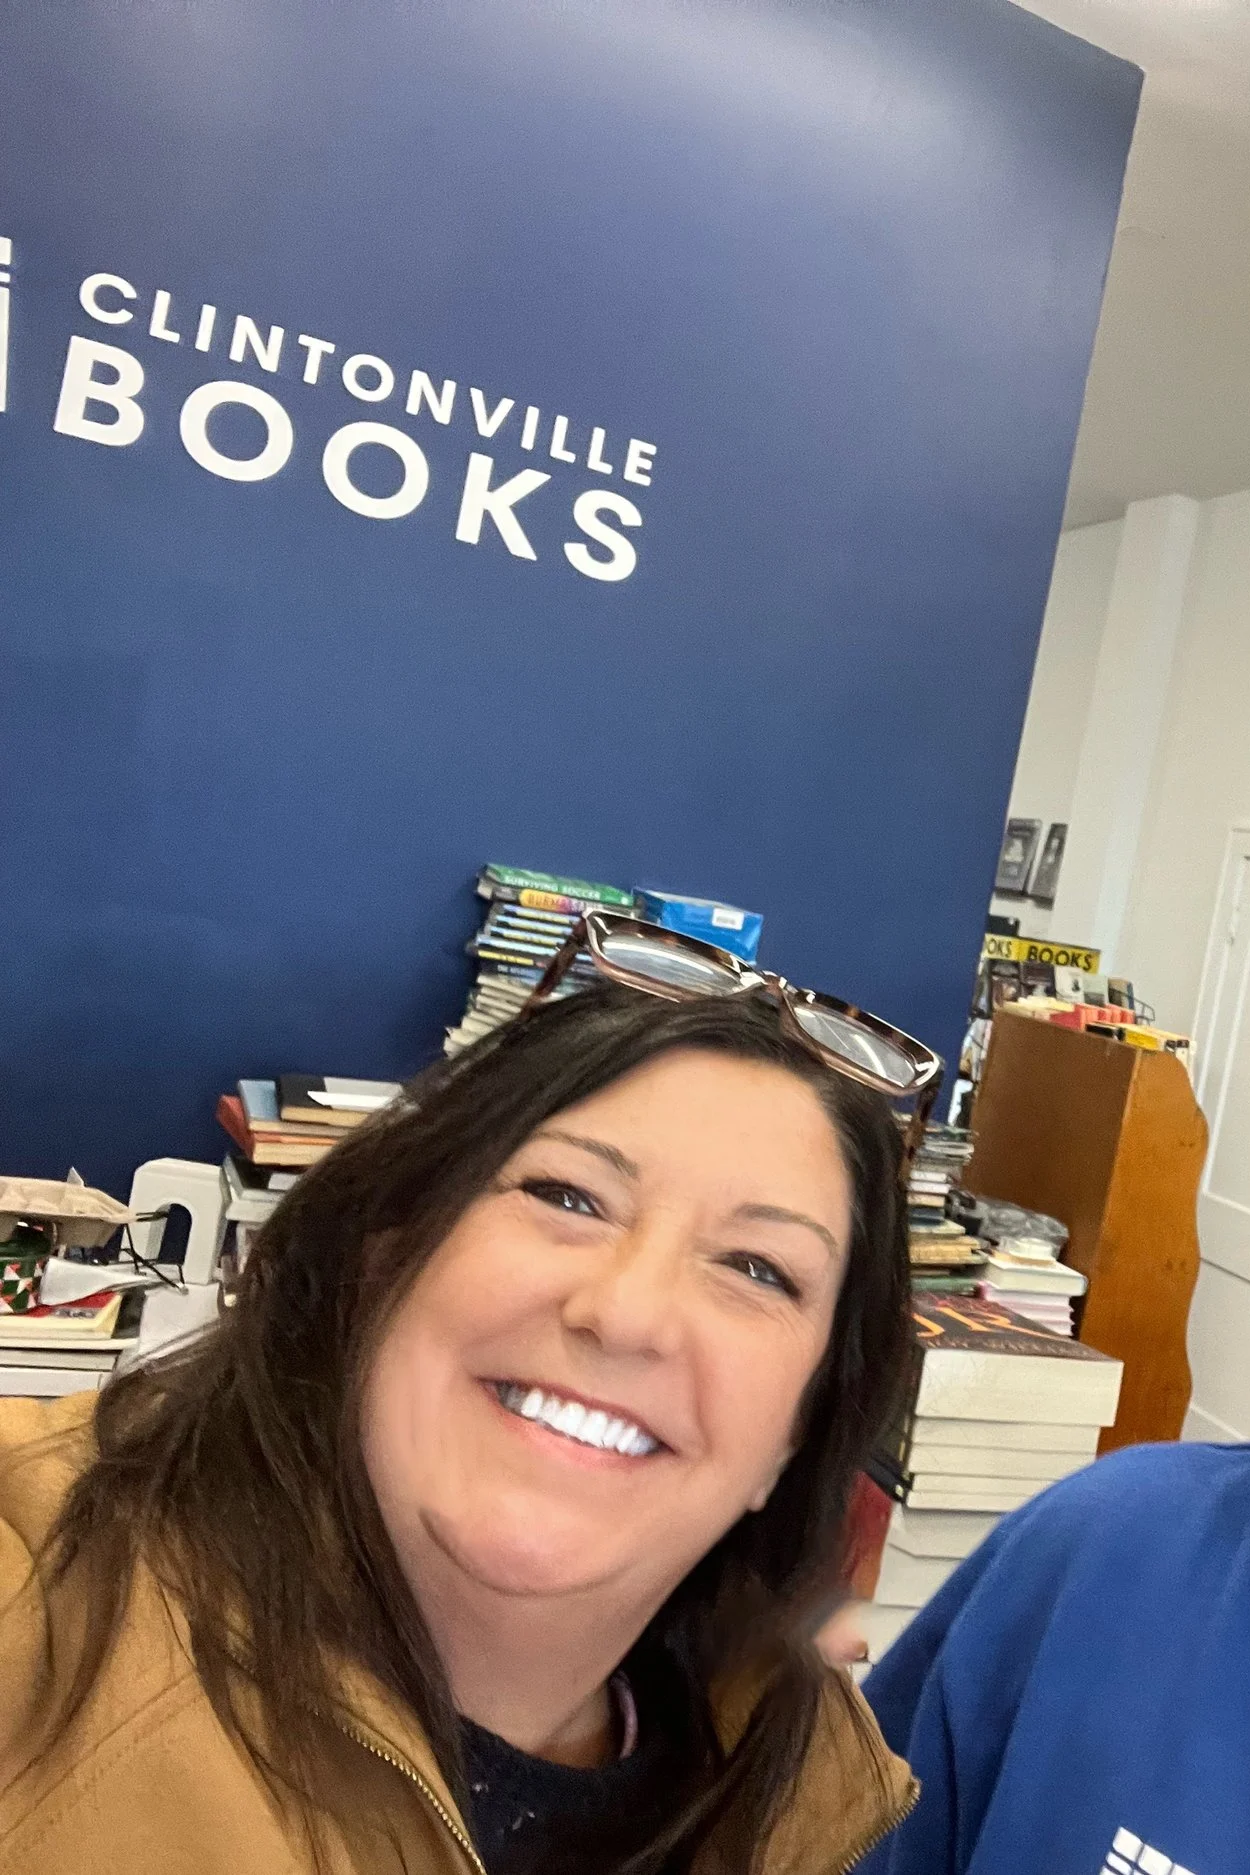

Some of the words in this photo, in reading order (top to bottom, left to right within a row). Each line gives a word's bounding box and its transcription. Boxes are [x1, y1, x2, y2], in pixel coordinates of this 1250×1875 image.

[79, 273, 657, 486] CLINTONVILLE
[53, 335, 643, 582] BOOKS
[504, 875, 558, 892] SURVIVING
[562, 886, 600, 901] SOCCER
[1027, 945, 1093, 972] BOOKS
